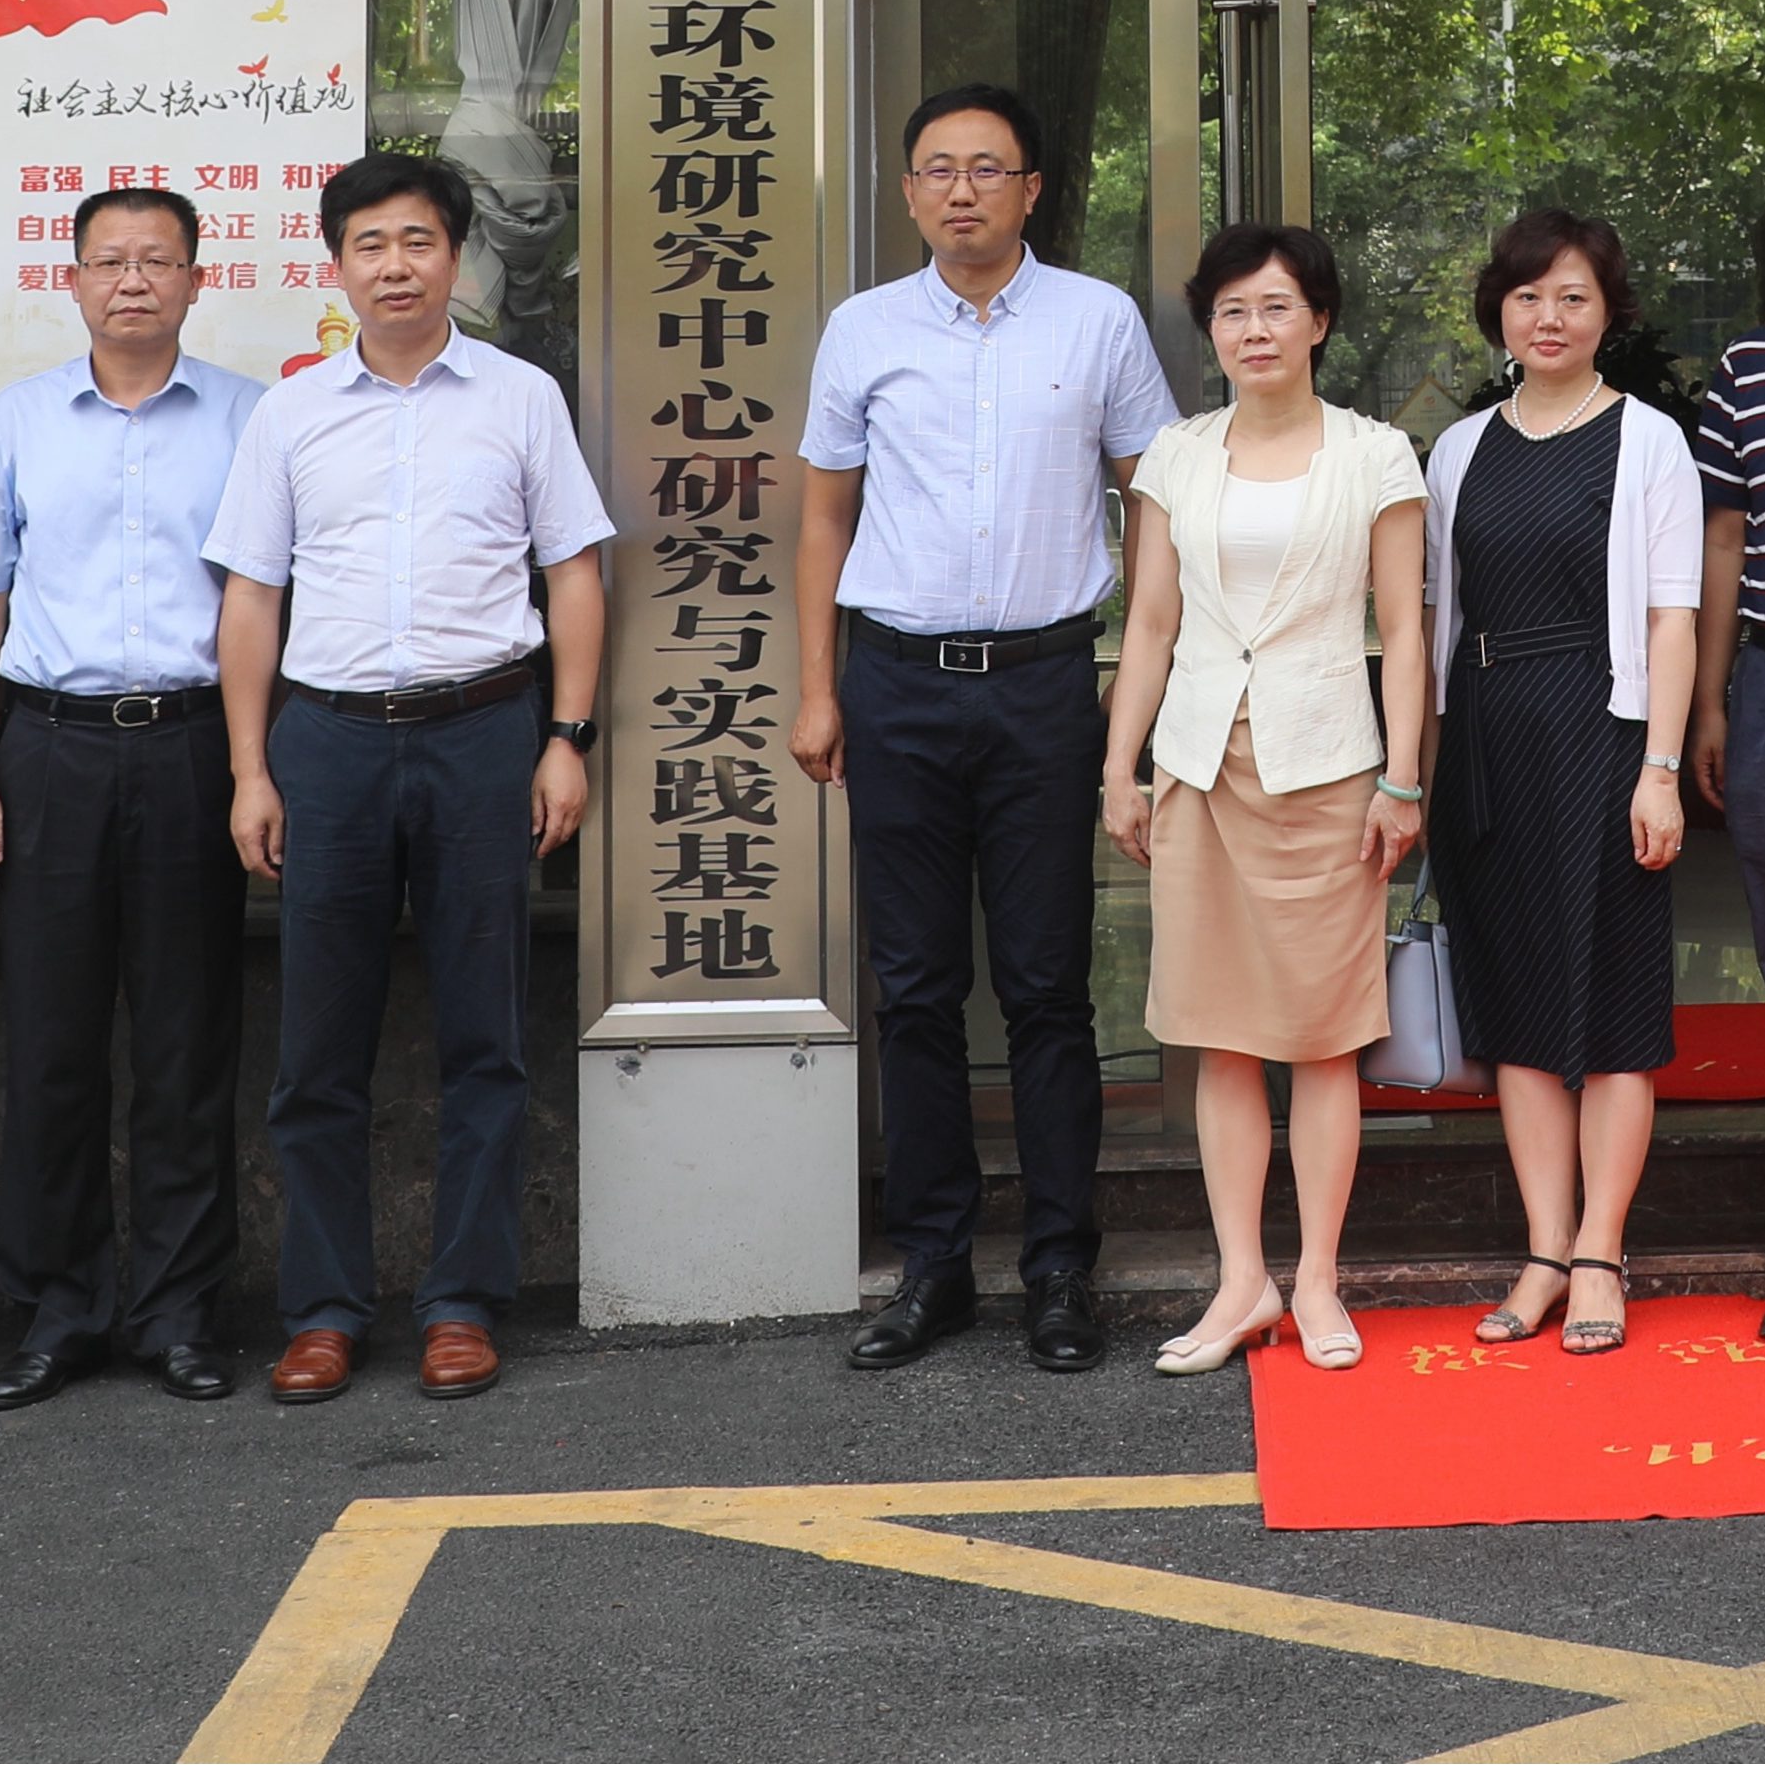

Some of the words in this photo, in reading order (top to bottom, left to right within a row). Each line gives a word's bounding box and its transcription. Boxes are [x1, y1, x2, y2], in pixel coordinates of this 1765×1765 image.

[16, 74, 356, 124] 社会主义核心价值观
[20, 165, 84, 193] 富强
[107, 165, 172, 193] 民主
[193, 163, 259, 192] 文明
